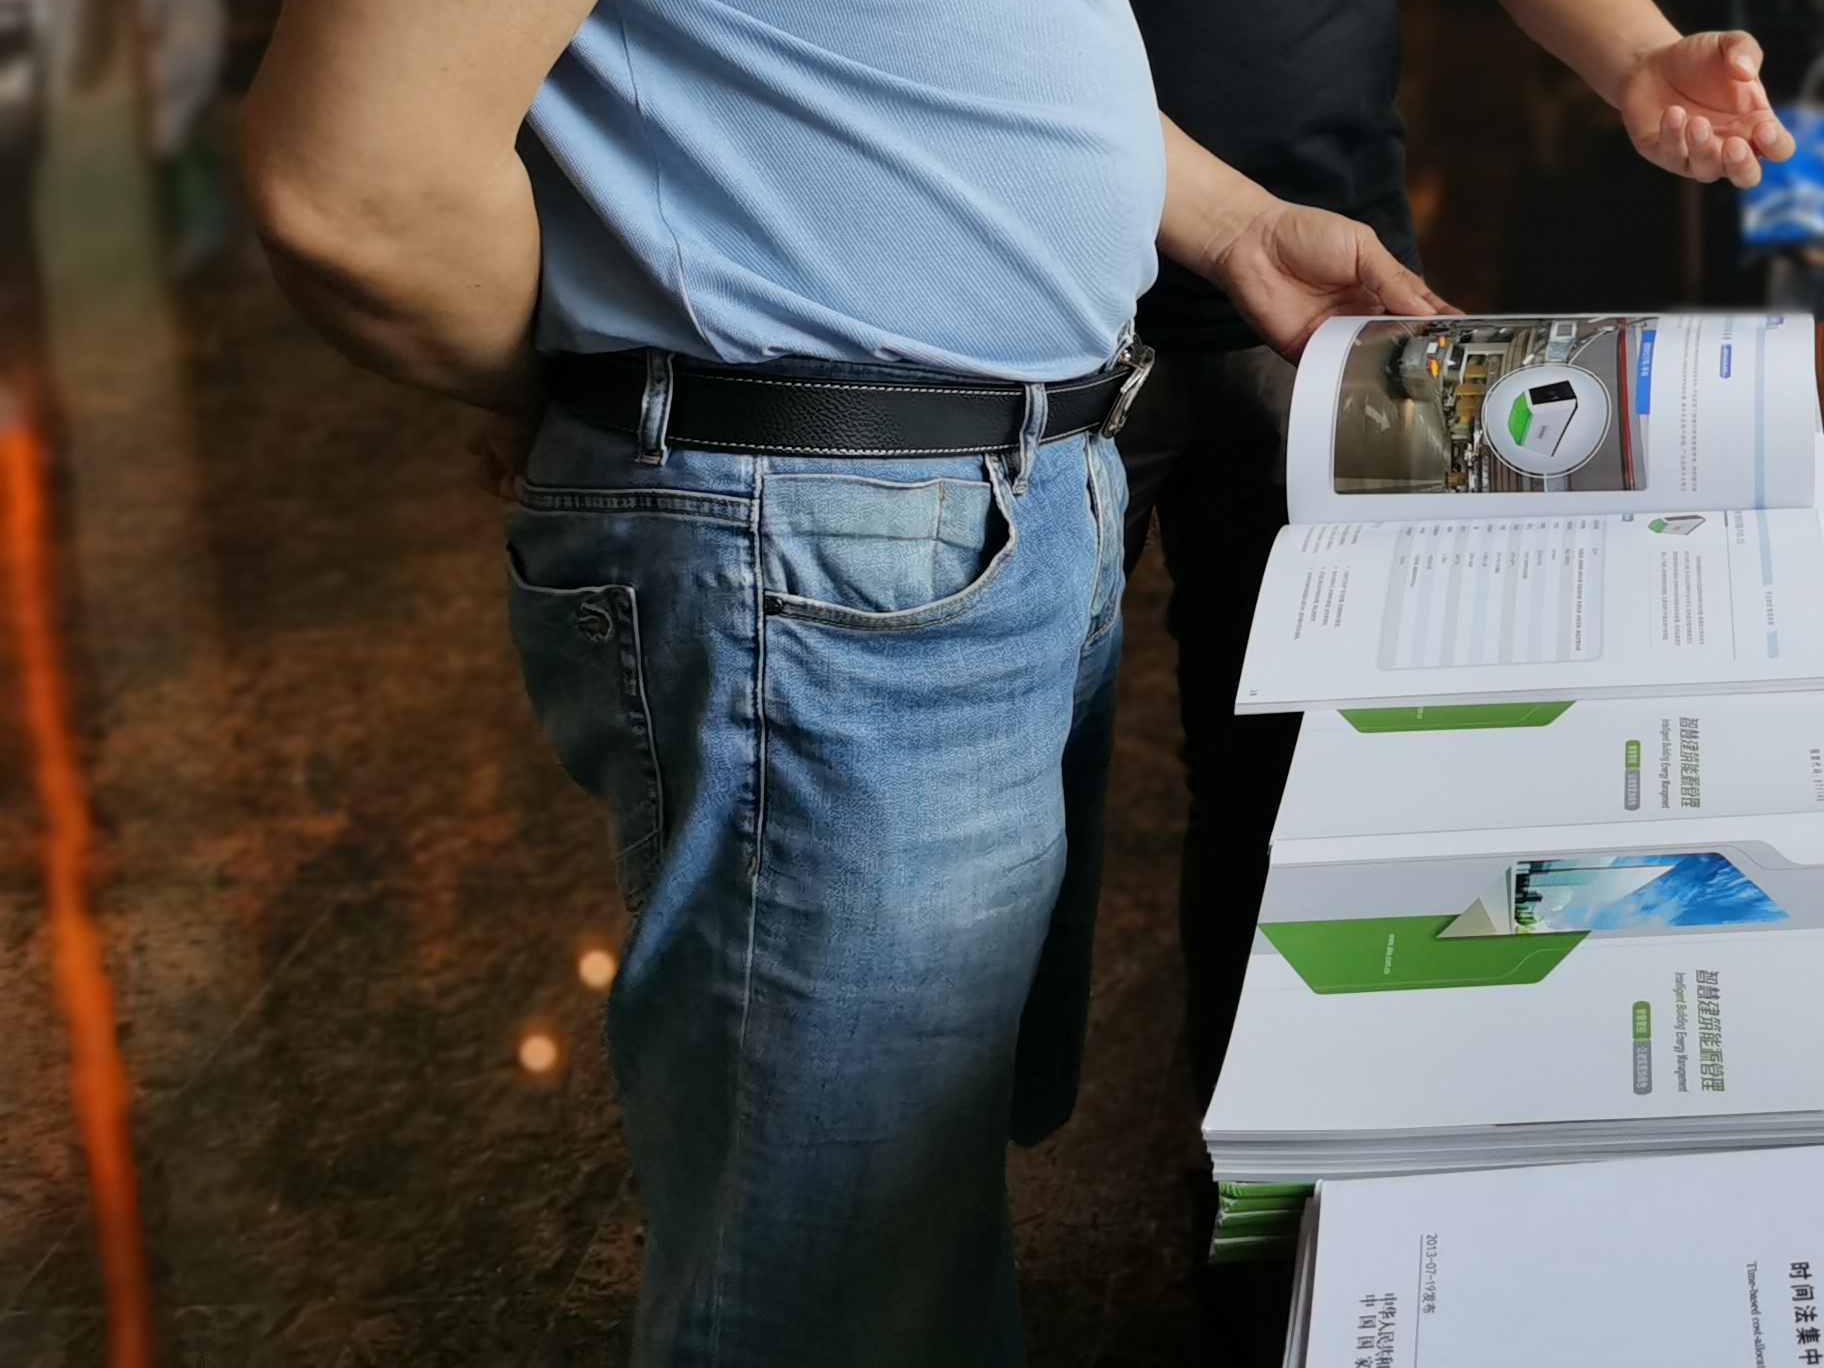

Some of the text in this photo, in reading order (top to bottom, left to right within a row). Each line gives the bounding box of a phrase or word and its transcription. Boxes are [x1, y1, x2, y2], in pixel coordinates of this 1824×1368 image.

[1659, 718, 1672, 809] Intelligent Building Energy Management
[1679, 717, 1700, 808] 智慧建筑能源管理
[1673, 972, 1689, 1093] Intelligent Building Energy Management
[1696, 969, 1725, 1092] 智慧建筑能源管理
[1422, 1233, 1438, 1315] 2013-07-19发布
[1746, 1261, 1762, 1316] Time-based
[1789, 1262, 1824, 1366] 时间法集中
[1354, 1293, 1377, 1368] 中国国家
[1375, 1292, 1398, 1368] 中华人民共和
